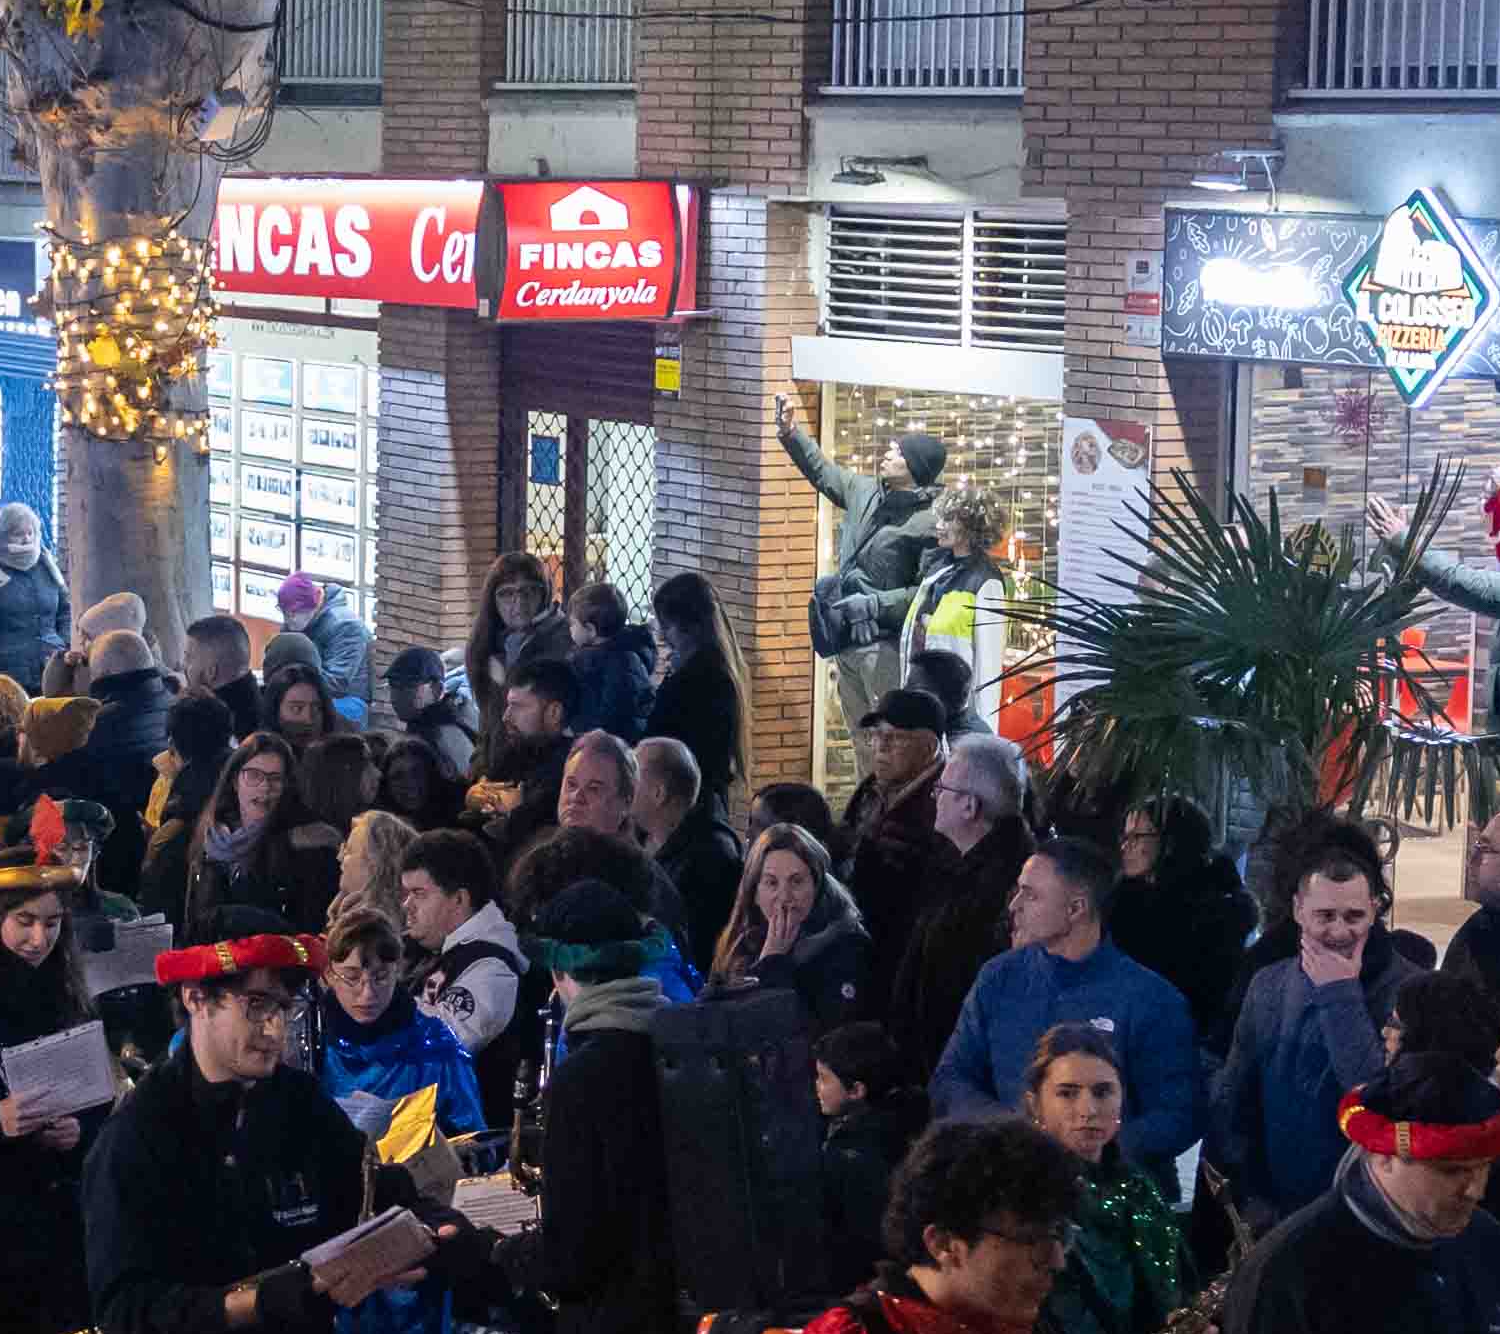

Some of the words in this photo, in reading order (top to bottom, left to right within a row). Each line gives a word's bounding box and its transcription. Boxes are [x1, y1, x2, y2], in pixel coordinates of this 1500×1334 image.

[219, 203, 373, 278] NCAS
[519, 240, 662, 271] FINCAS
[516, 278, 658, 311] Cerdanyola
[1375, 323, 1447, 351] PIZZERIA
